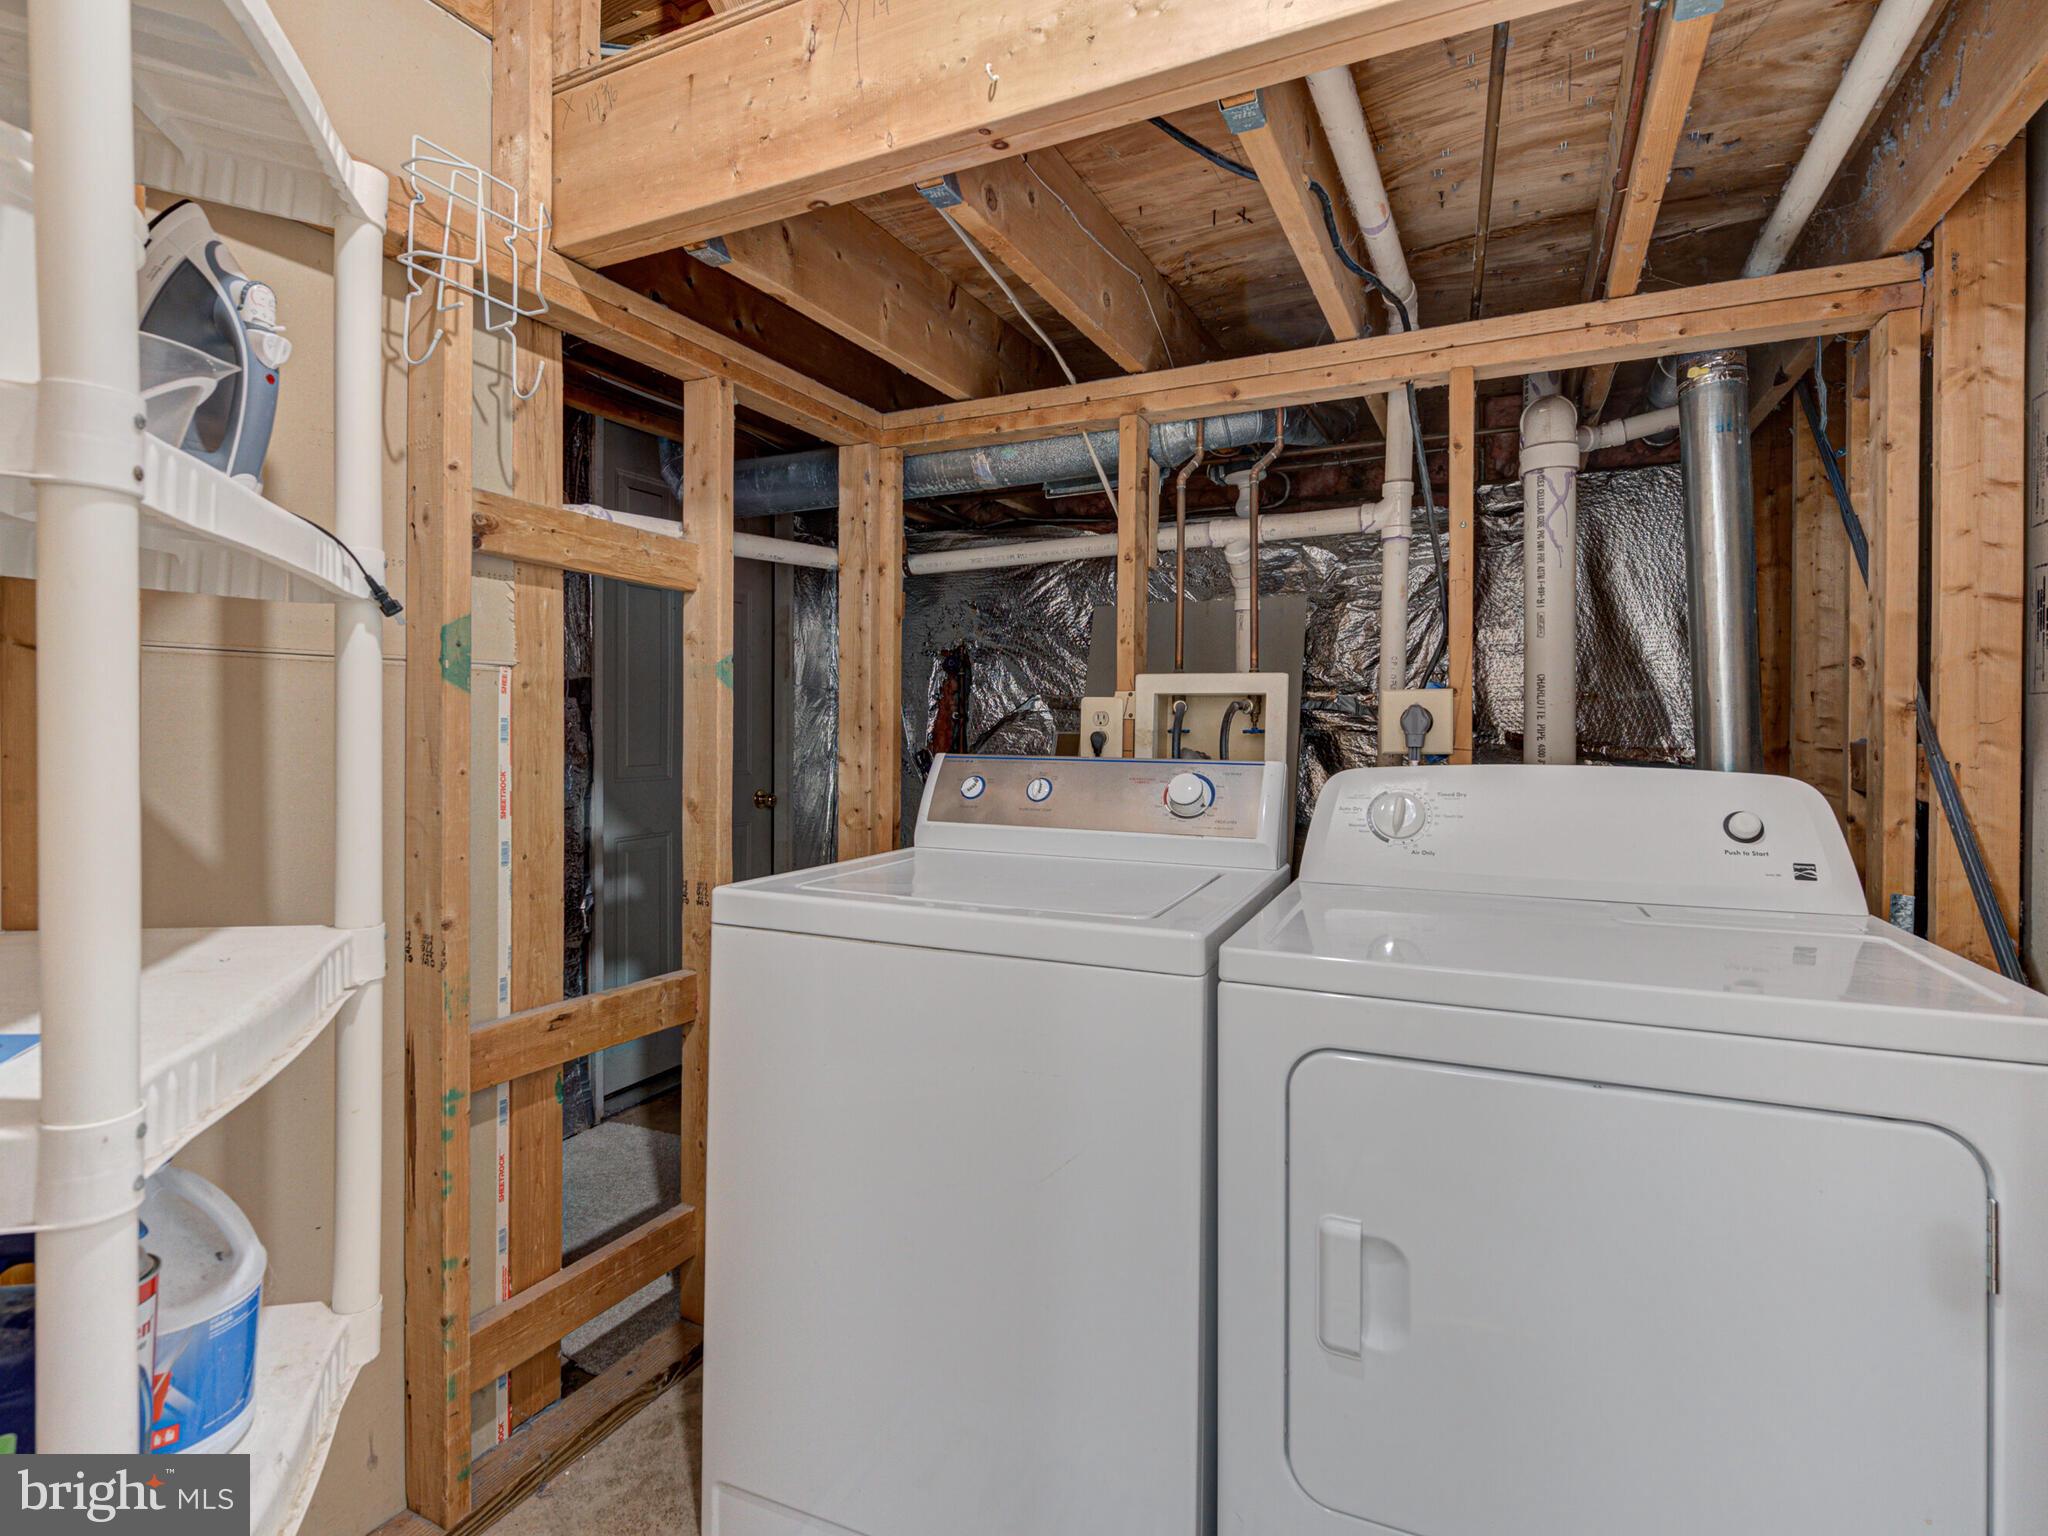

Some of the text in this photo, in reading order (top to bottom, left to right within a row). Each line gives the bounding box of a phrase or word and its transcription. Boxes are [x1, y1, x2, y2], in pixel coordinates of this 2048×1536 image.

[1536, 673, 1546, 720] CHARLOTTE
[1536, 723, 1546, 741] PIPE
[499, 771, 507, 820] SHEETROCK
[1421, 849, 1436, 857] Only
